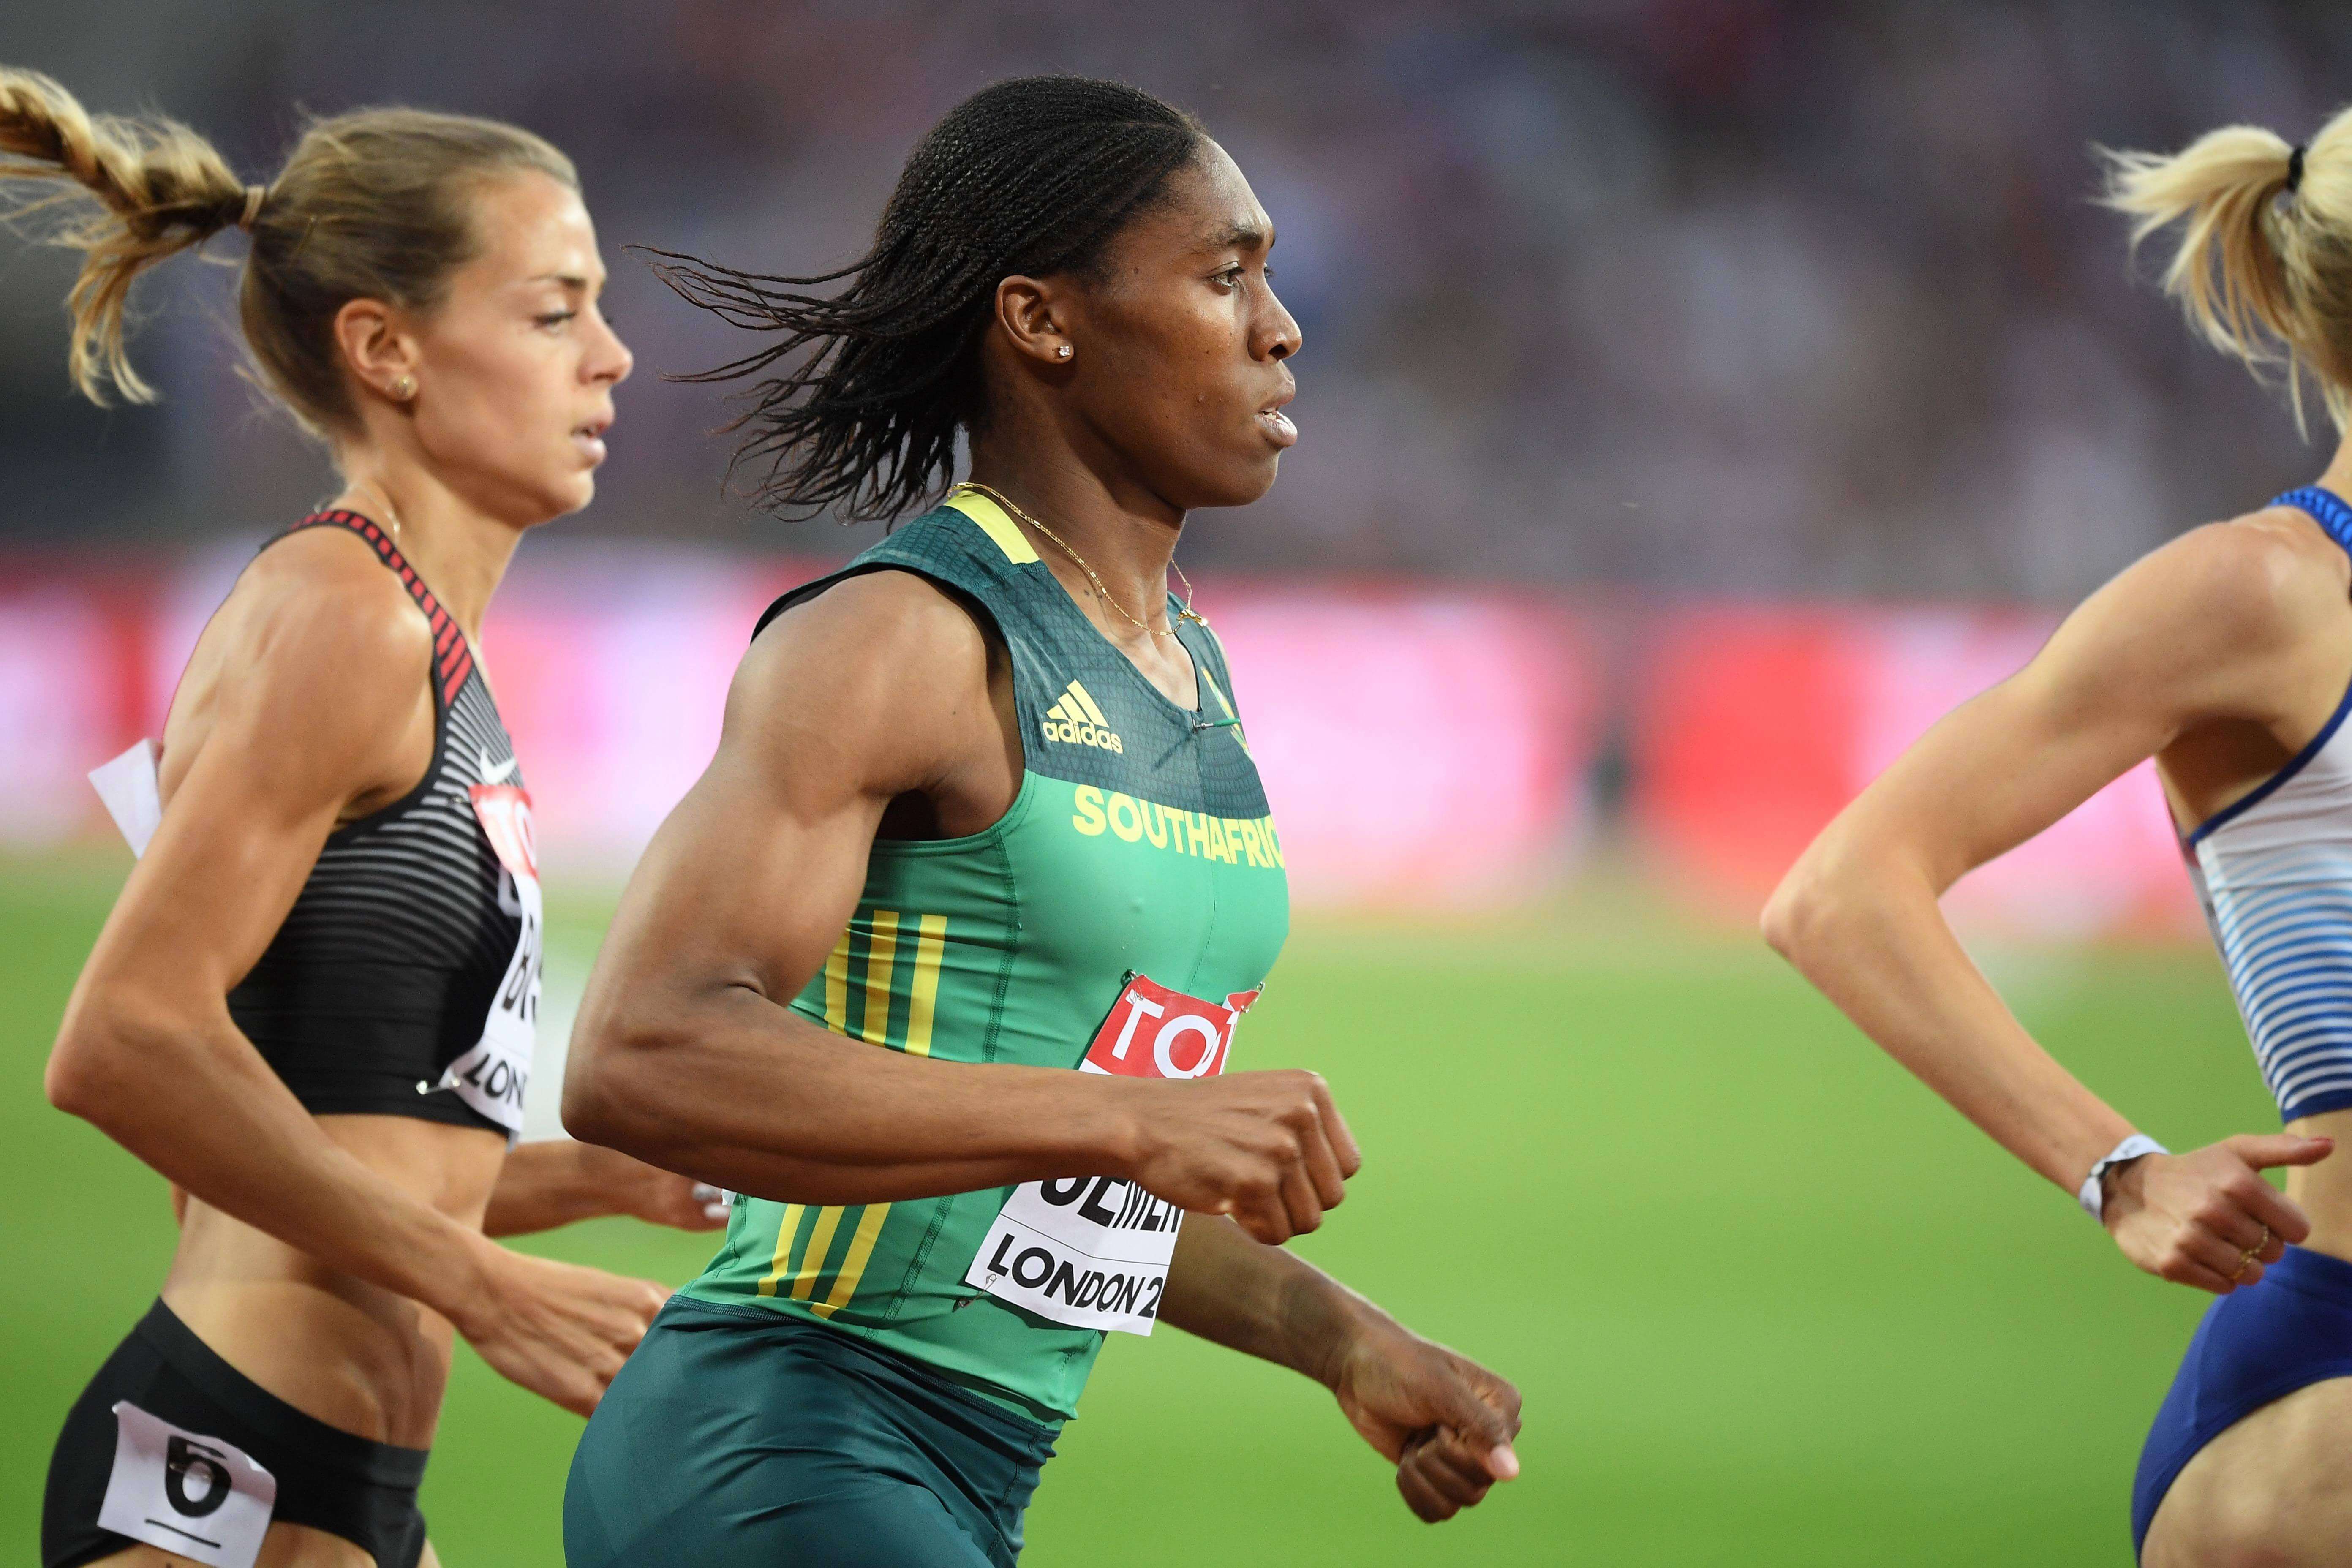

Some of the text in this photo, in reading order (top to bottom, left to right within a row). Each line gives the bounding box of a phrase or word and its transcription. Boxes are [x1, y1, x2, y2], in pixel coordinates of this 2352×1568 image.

[1042, 719, 1123, 754] adidas
[463, 1053, 526, 1109] LON
[987, 1233, 1146, 1314] LONDON
[165, 1435, 231, 1518] 6
